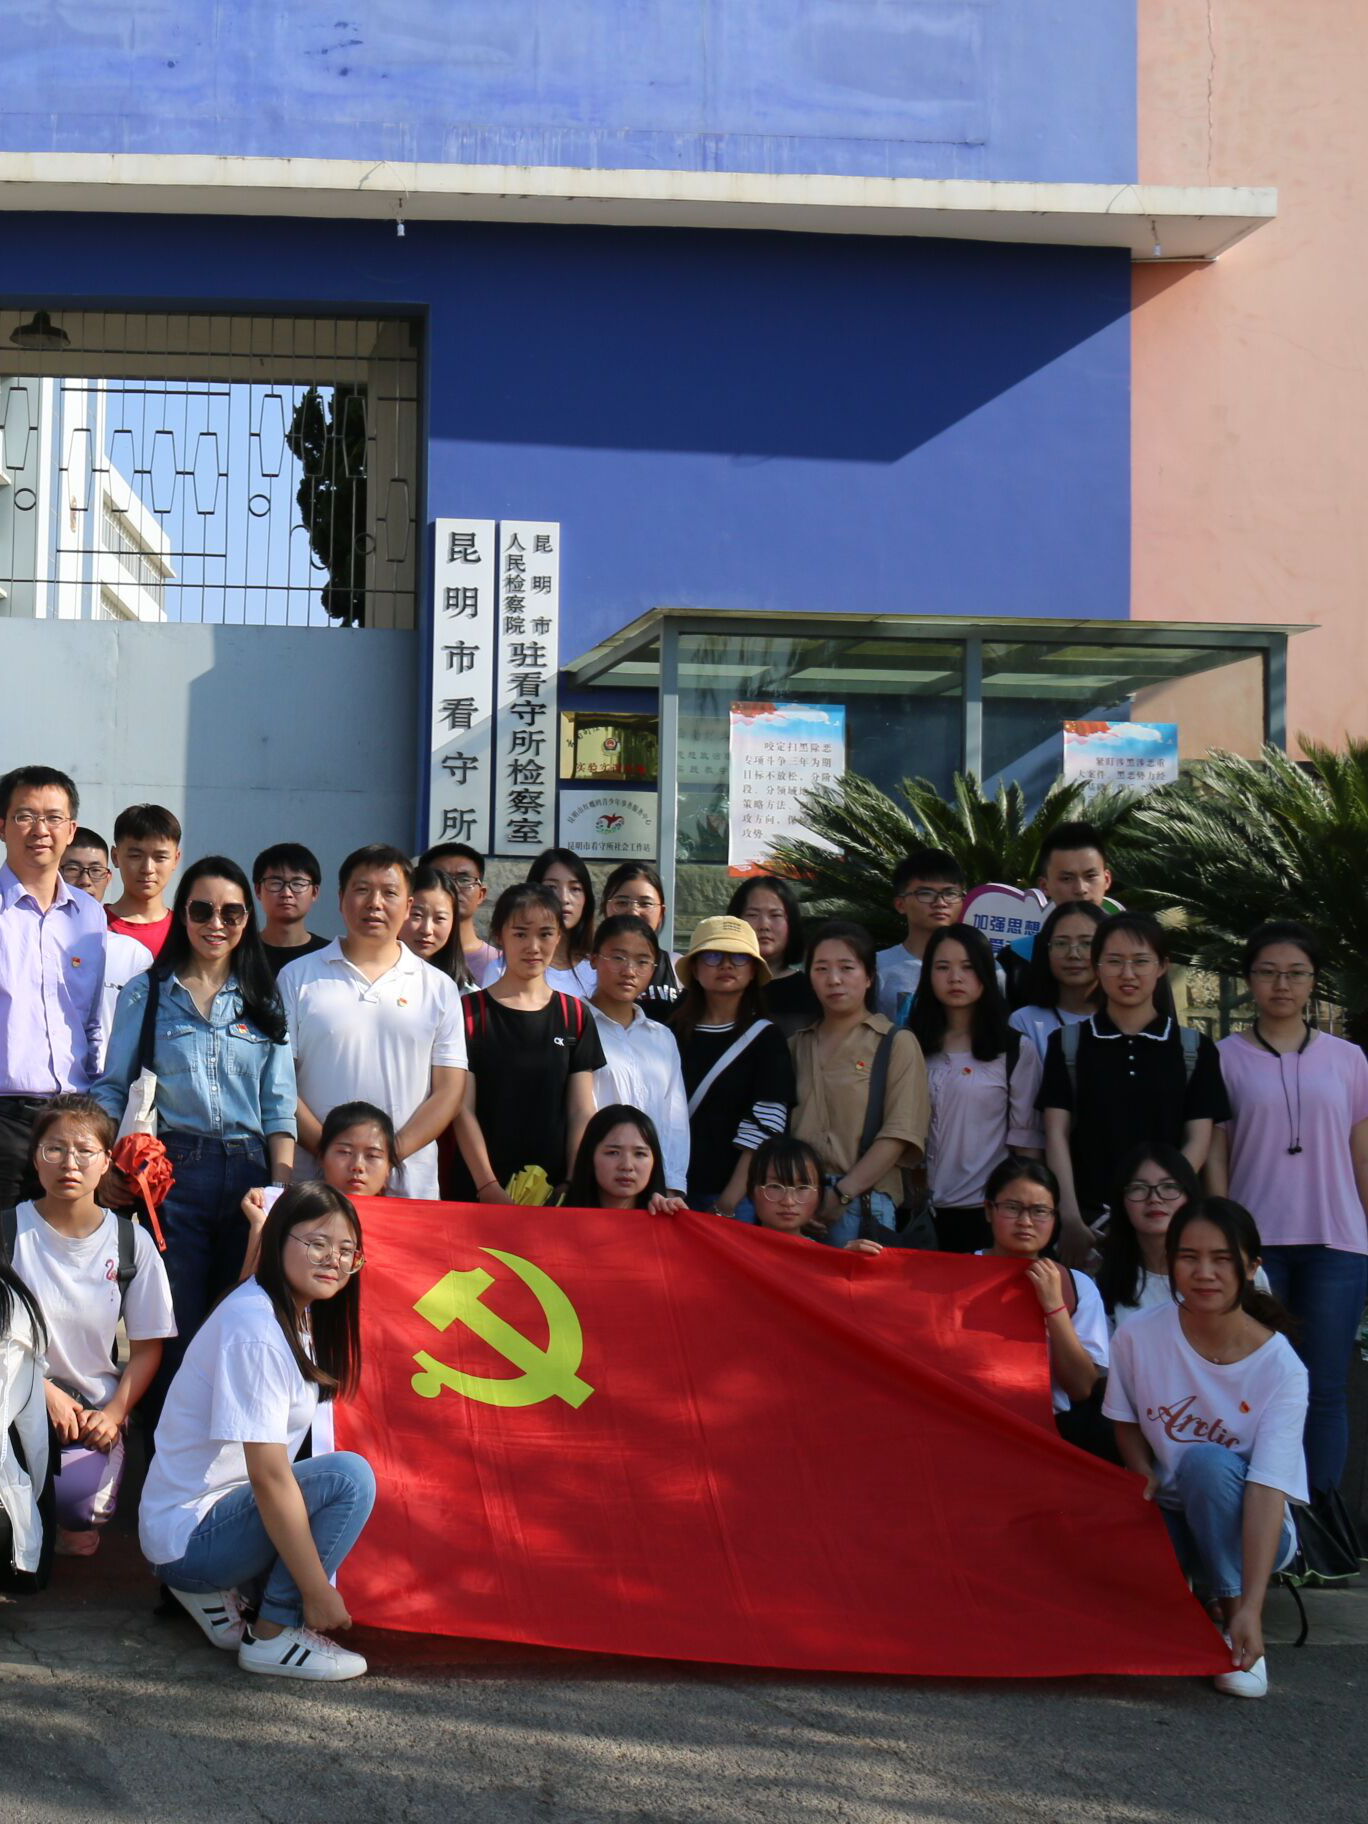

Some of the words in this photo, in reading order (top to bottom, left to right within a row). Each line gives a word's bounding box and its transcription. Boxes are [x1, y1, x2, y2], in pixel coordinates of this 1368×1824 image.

[504, 533, 526, 635] 人民检察院
[532, 534, 553, 635] 昆明市
[440, 532, 481, 841] 昆明市看守所
[507, 641, 547, 844] 驻看守所检察室
[744, 755, 832, 768] 专项斗争三年为期
[764, 742, 832, 753] 咬定扫黑除恶
[567, 841, 651, 852] 昆明市看守所社会工作站
